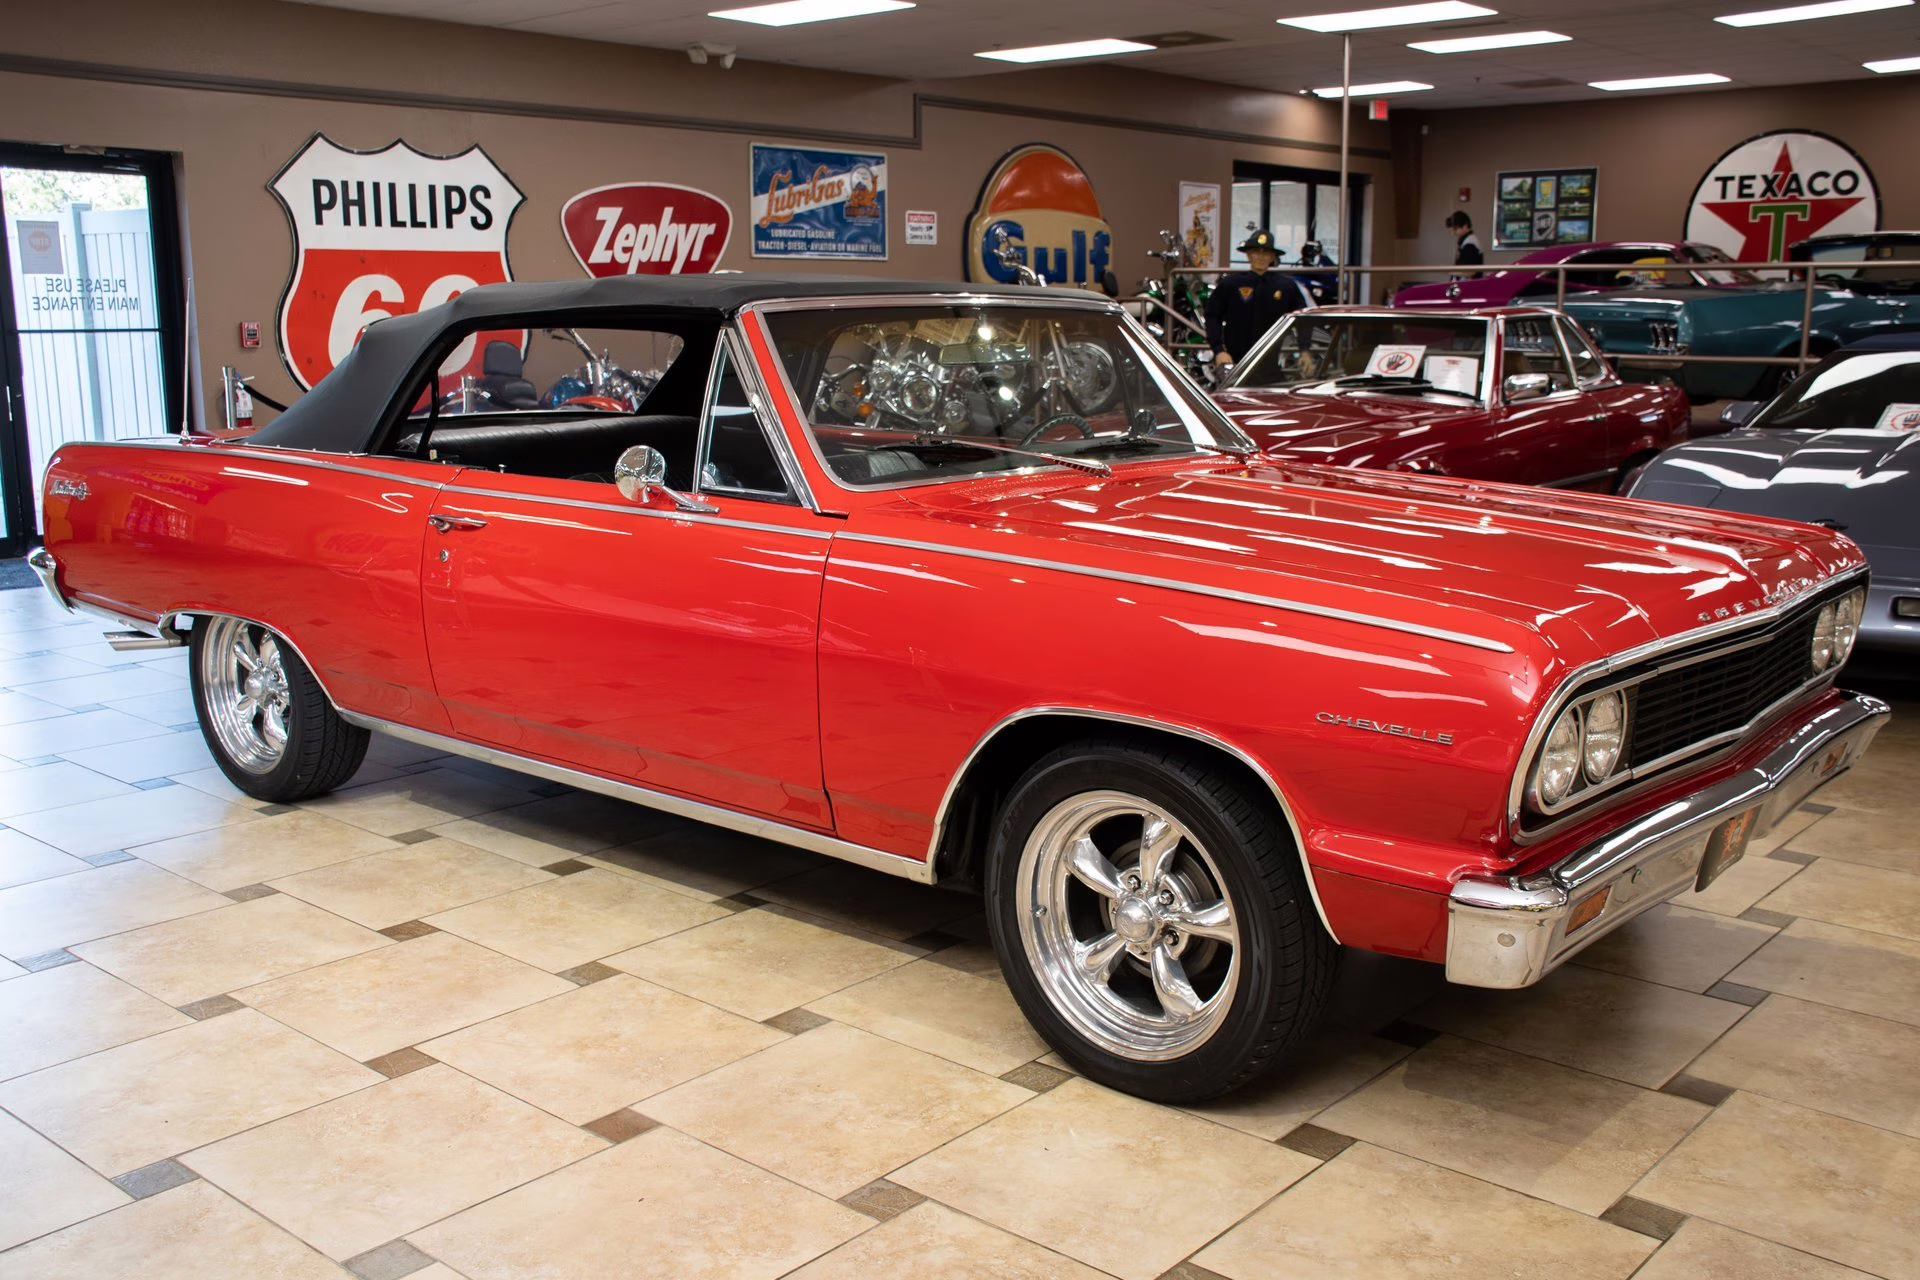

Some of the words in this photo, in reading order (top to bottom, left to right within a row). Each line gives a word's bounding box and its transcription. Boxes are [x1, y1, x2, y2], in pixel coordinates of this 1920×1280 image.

[312, 178, 493, 231] PHILLIPS
[1715, 170, 1859, 200] TEXACO
[588, 207, 716, 275] Zephyr
[770, 228, 806, 238] LUBRICATED
[806, 229, 835, 239] GASOLINE
[982, 220, 1110, 284] Gulf
[1315, 711, 1454, 746] CHEVELLE
